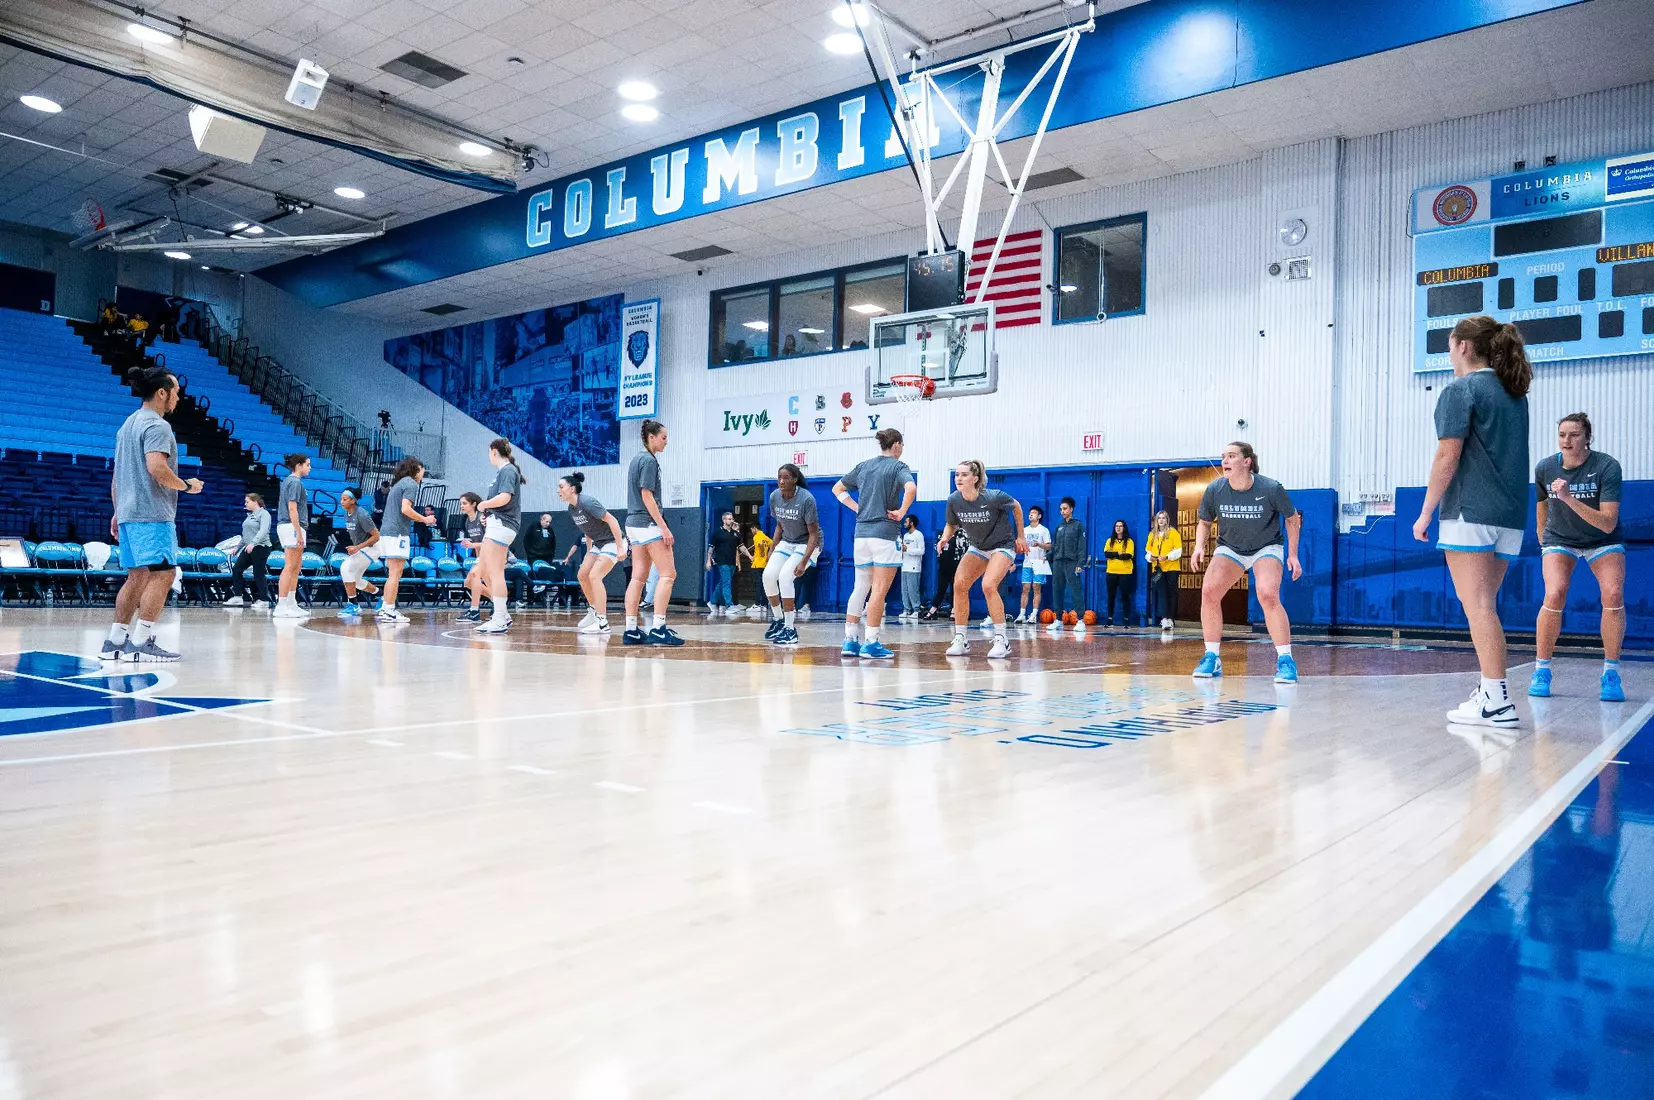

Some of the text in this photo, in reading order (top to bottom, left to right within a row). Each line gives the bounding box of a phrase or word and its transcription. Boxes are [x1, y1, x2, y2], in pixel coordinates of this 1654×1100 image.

[527, 82, 940, 248] COLUMBIA
[1503, 171, 1592, 193] COLUMBIA
[1524, 192, 1570, 207] LIONS
[1424, 265, 1489, 284] COLUMBIA
[1527, 262, 1565, 275] PERIOD
[1509, 304, 1584, 321] PLAYER FOUL
[1597, 301, 1627, 312] T.O.L.
[625, 394, 648, 408] 2023
[789, 396, 799, 415] C
[723, 410, 754, 436] Ivy
[842, 416, 852, 432] P
[868, 415, 880, 430] Y
[1083, 435, 1101, 449] EXIT
[794, 453, 805, 464] EXIT
[1220, 504, 1264, 512] COLUMBIA
